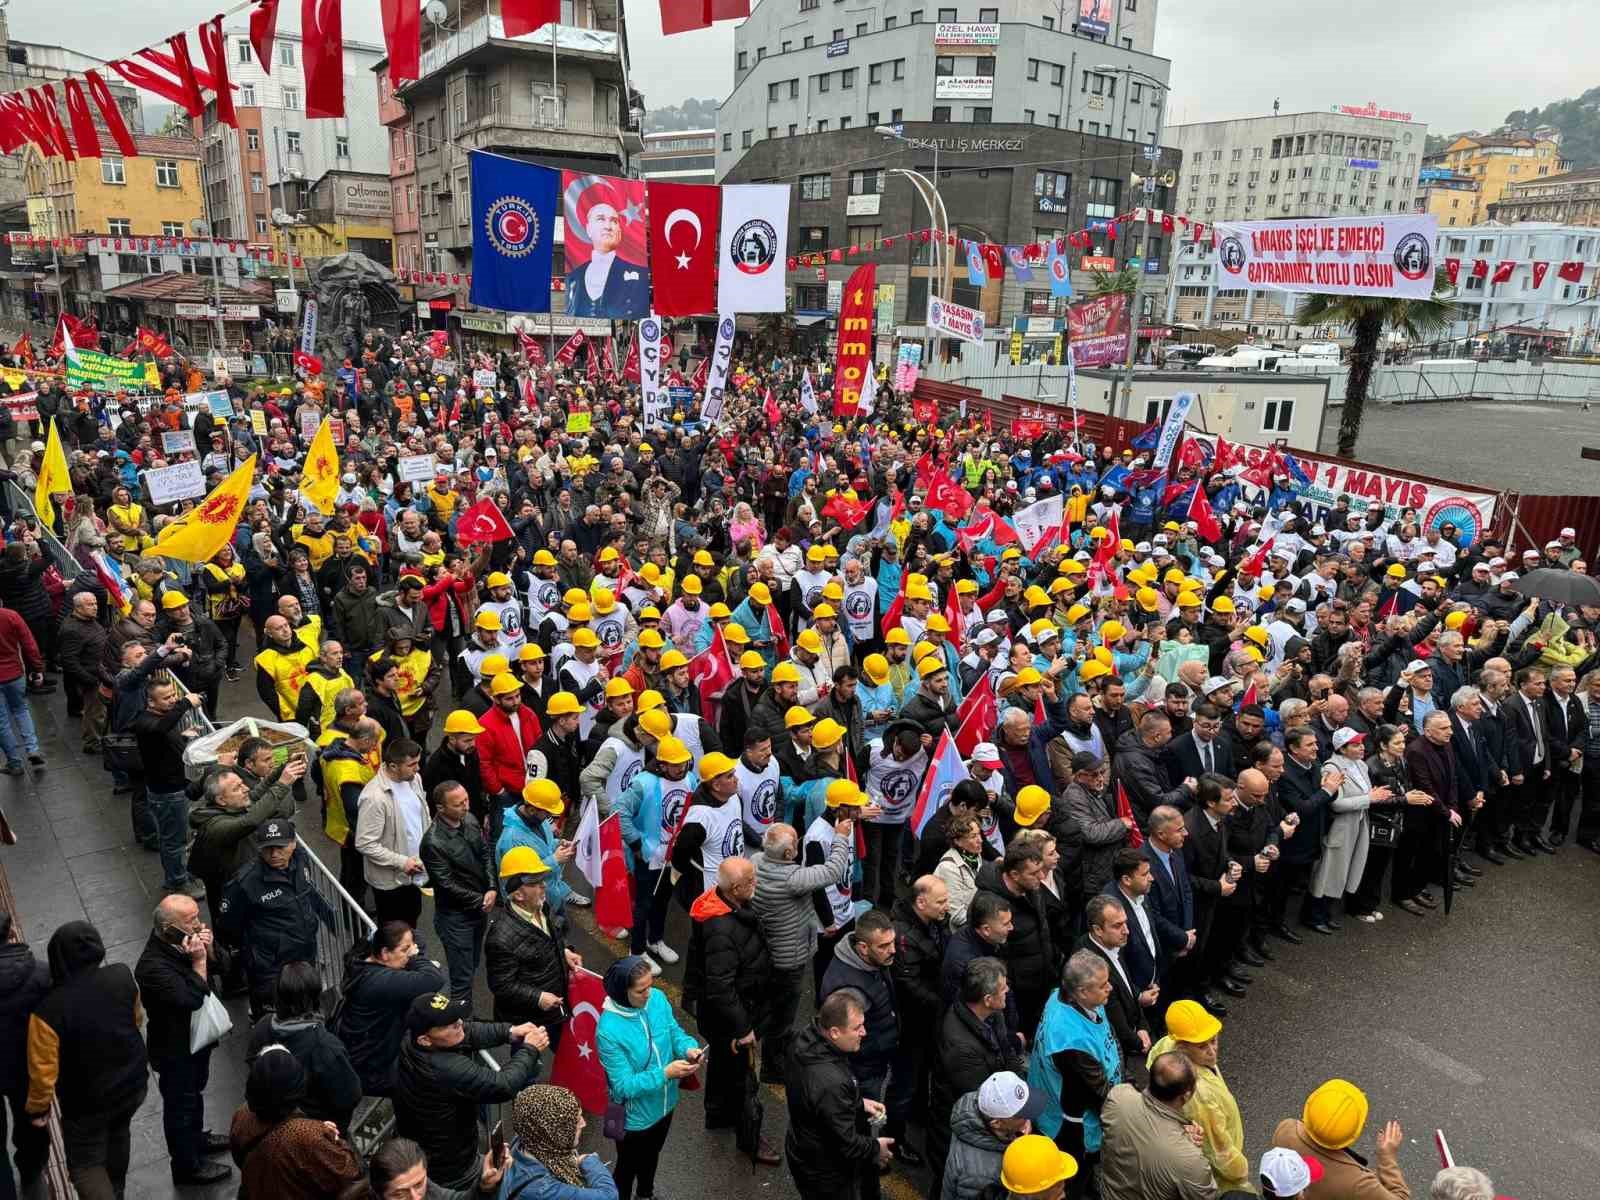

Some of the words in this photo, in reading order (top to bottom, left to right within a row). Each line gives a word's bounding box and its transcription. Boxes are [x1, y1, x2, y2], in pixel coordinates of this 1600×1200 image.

[939, 24, 964, 32] ÖZEL
[971, 136, 1025, 151] MERKEZİ
[346, 183, 390, 197] Ottoman
[1251, 231, 1257, 250] 1
[1259, 226, 1293, 251] MAYIS
[1294, 223, 1318, 256] İŞÇİ
[1321, 228, 1335, 251] VE
[1338, 221, 1386, 254] EMEKÇİ
[1248, 262, 1314, 284] BAYRAMIMIZ
[1316, 263, 1350, 286] KUTLU
[1353, 264, 1394, 288] OLSUN
[948, 318, 972, 335] MAYIS
[843, 288, 867, 404] tmmob
[1325, 464, 1338, 489] 1
[1342, 469, 1429, 510] MAYIS
